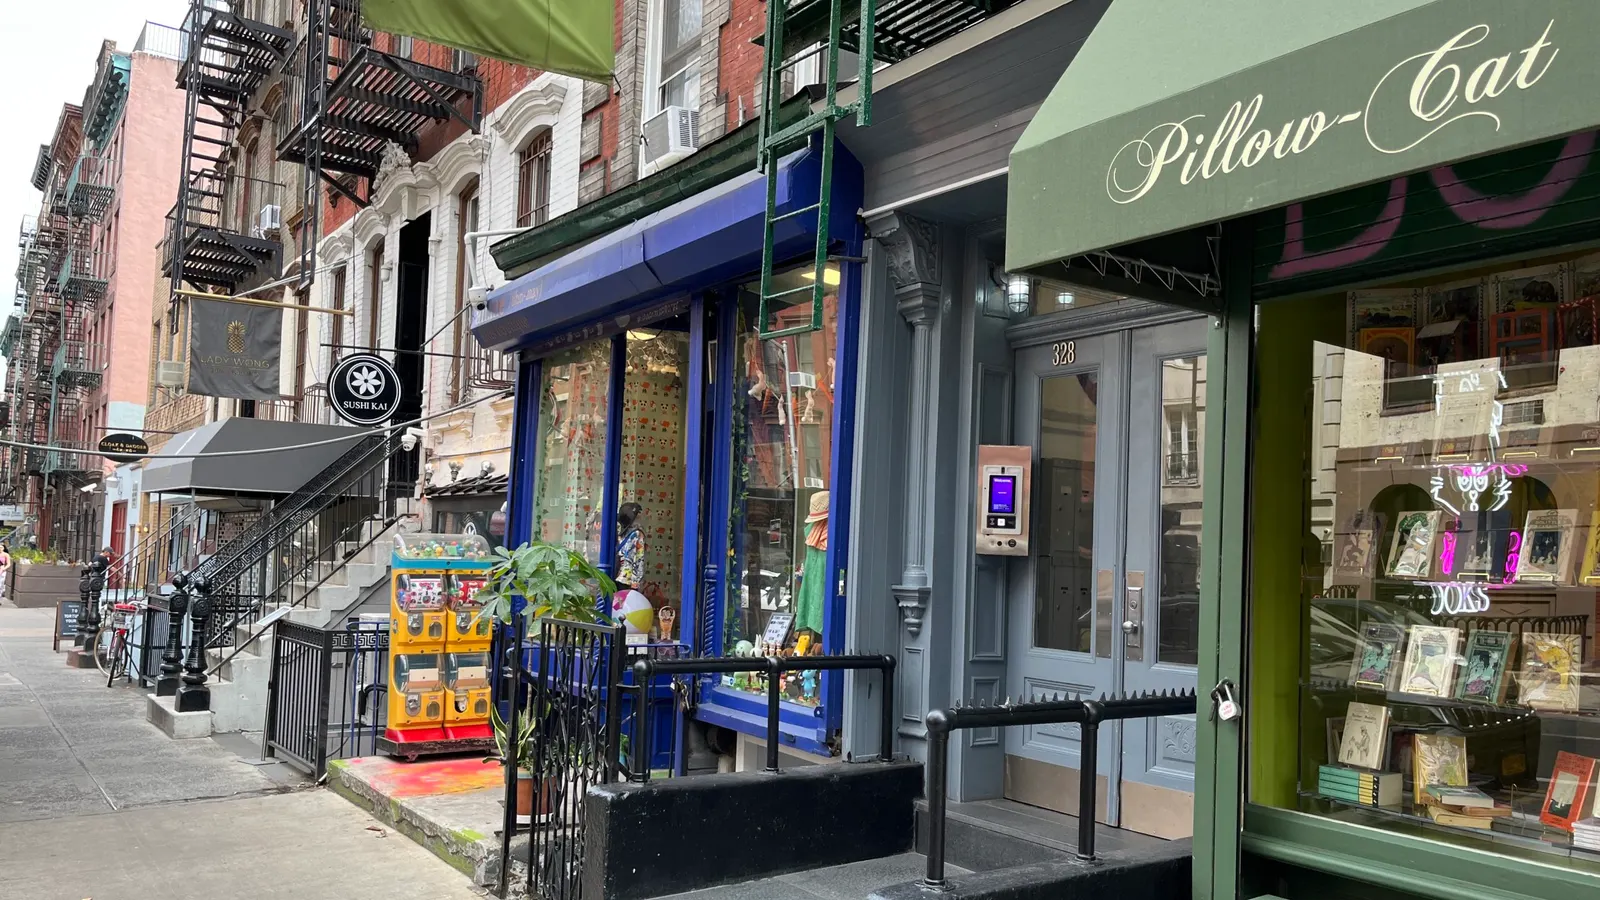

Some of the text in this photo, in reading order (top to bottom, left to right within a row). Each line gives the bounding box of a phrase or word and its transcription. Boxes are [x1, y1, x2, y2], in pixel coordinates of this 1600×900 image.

[1106, 18, 1560, 205] Pillow-Cat
[200, 355, 270, 369] LADY WONG
[1052, 341, 1076, 366] 328
[343, 400, 388, 411] SUSHI KAI
